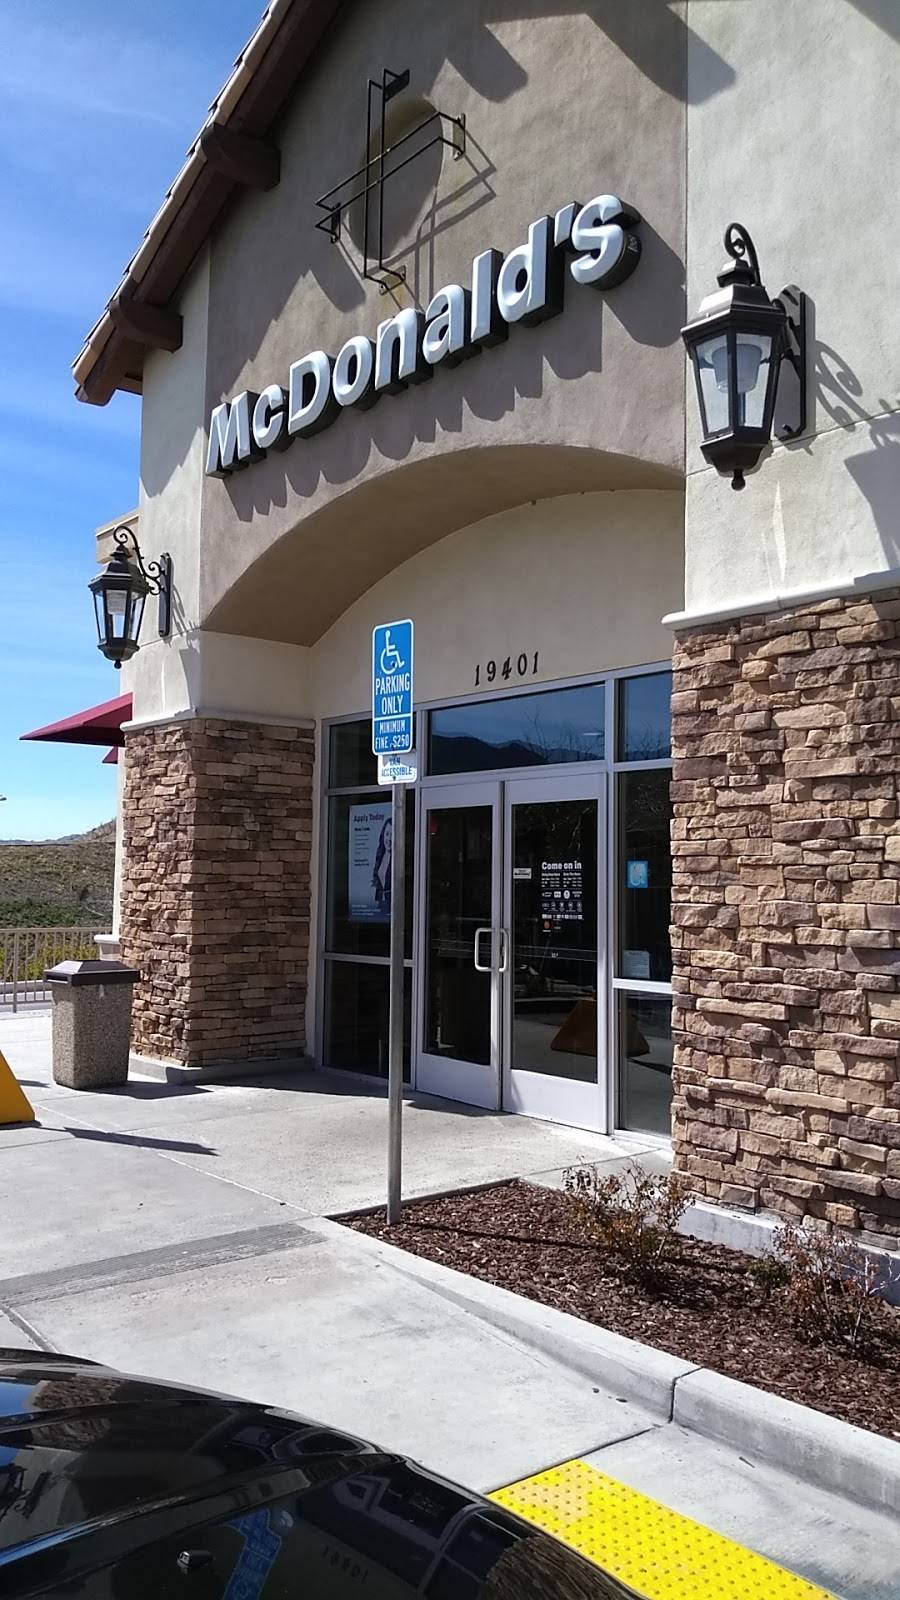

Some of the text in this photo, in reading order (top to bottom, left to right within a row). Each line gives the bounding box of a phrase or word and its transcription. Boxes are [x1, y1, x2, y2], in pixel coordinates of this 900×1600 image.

[205, 193, 626, 478] McDonald's
[475, 651, 539, 687] 19401
[375, 673, 411, 696] PARKING
[381, 695, 404, 715] ONLY
[379, 720, 406, 734] MINIMUM
[375, 734, 410, 749] FINE $250
[381, 766, 412, 777] ACCESSIBLE
[353, 812, 385, 823] Apply Today
[541, 860, 582, 870] Come on in
